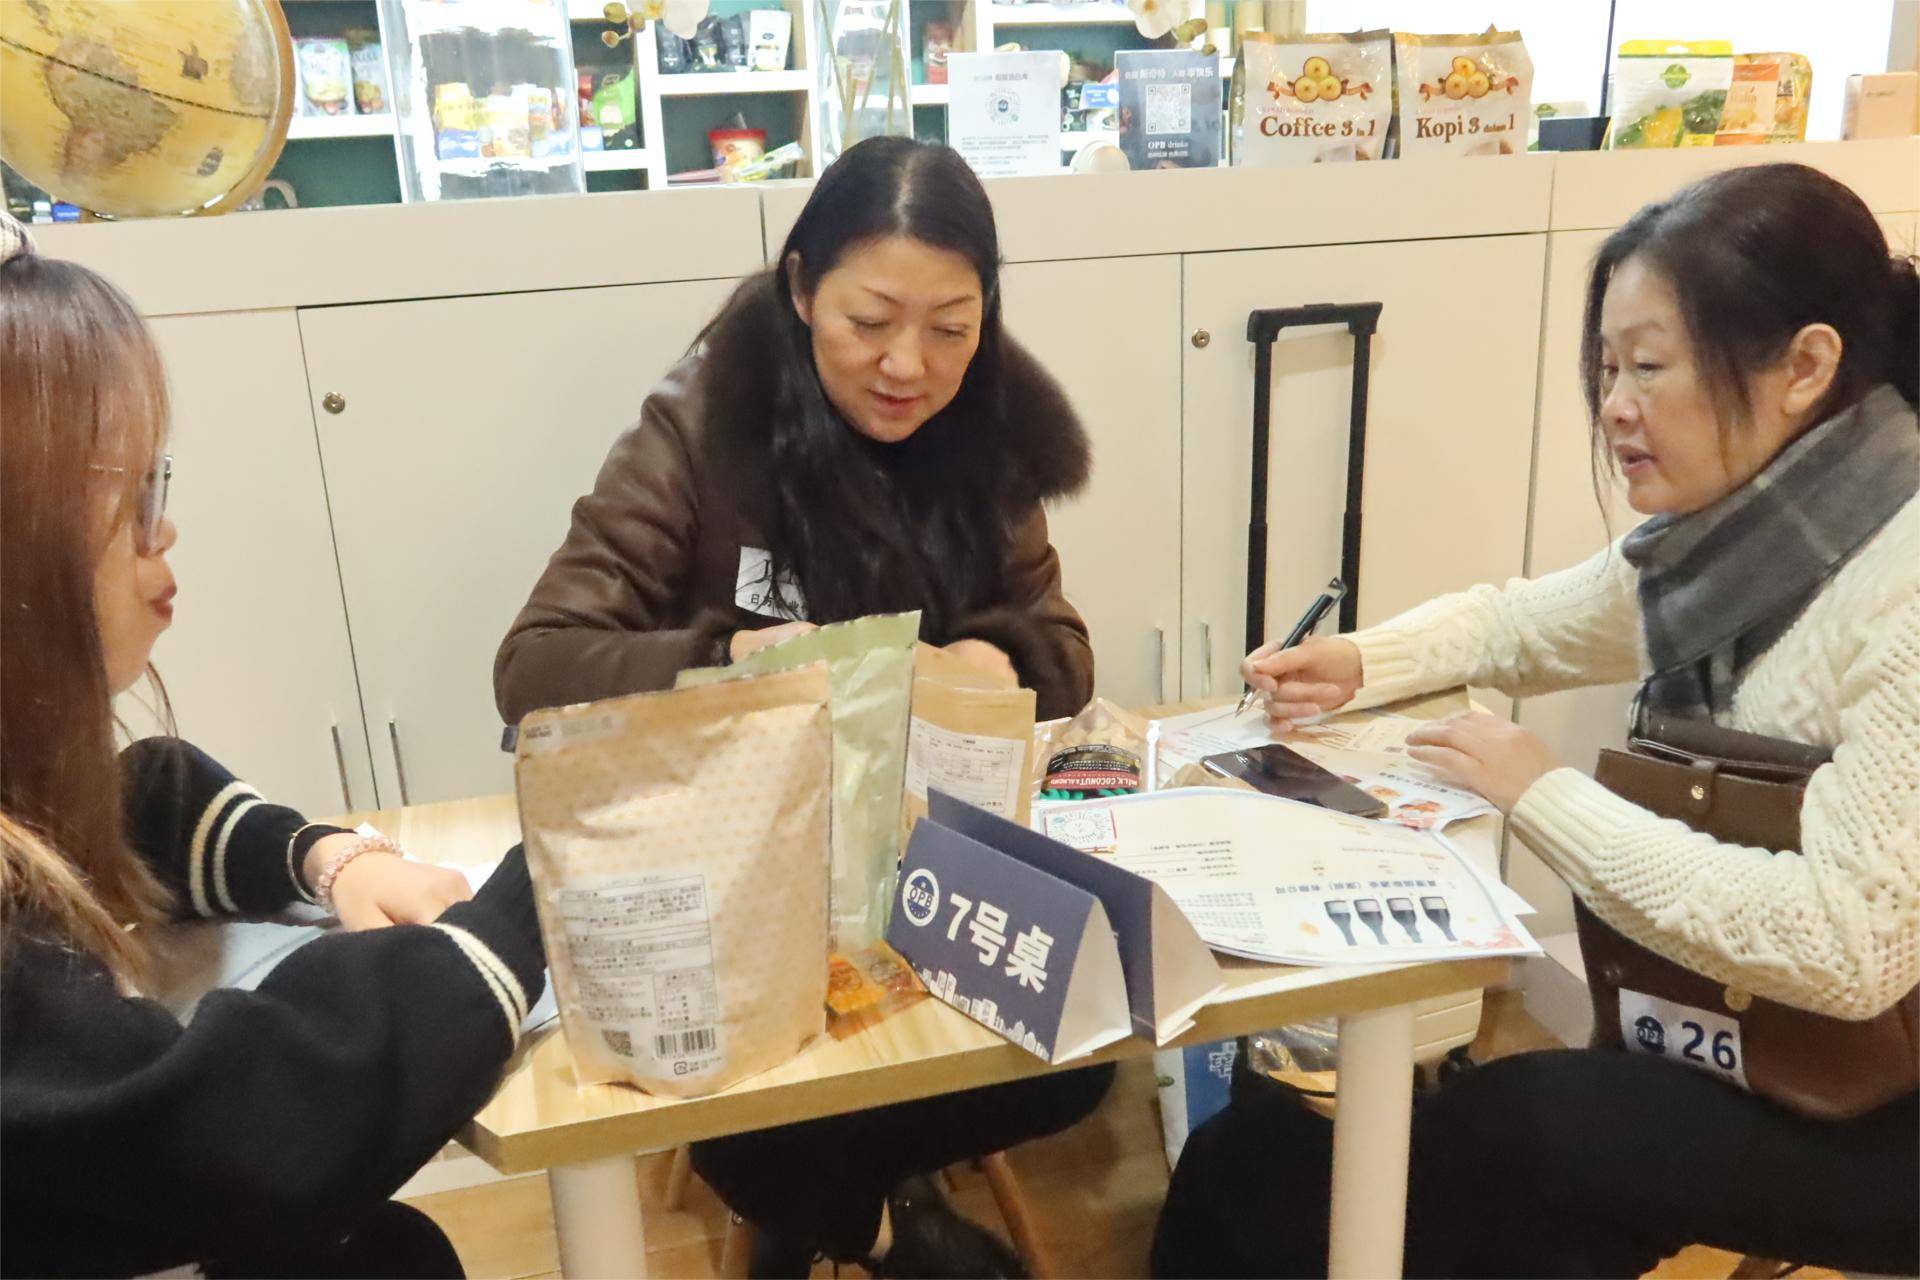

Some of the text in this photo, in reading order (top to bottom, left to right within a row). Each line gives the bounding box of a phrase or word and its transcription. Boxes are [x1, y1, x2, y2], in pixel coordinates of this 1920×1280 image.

[1260, 116, 1336, 138] Coffee
[1341, 119, 1353, 137] 3
[1368, 119, 1377, 137] 1
[1416, 115, 1464, 143] Kopi
[1468, 117, 1481, 134] 3
[1508, 114, 1516, 130] 1
[1148, 141, 1166, 150] OPB
[1079, 777, 1116, 786] COCONUT
[909, 887, 934, 908] OPB
[946, 893, 1055, 994] 7号桌
[1681, 1020, 1736, 1070] 26
